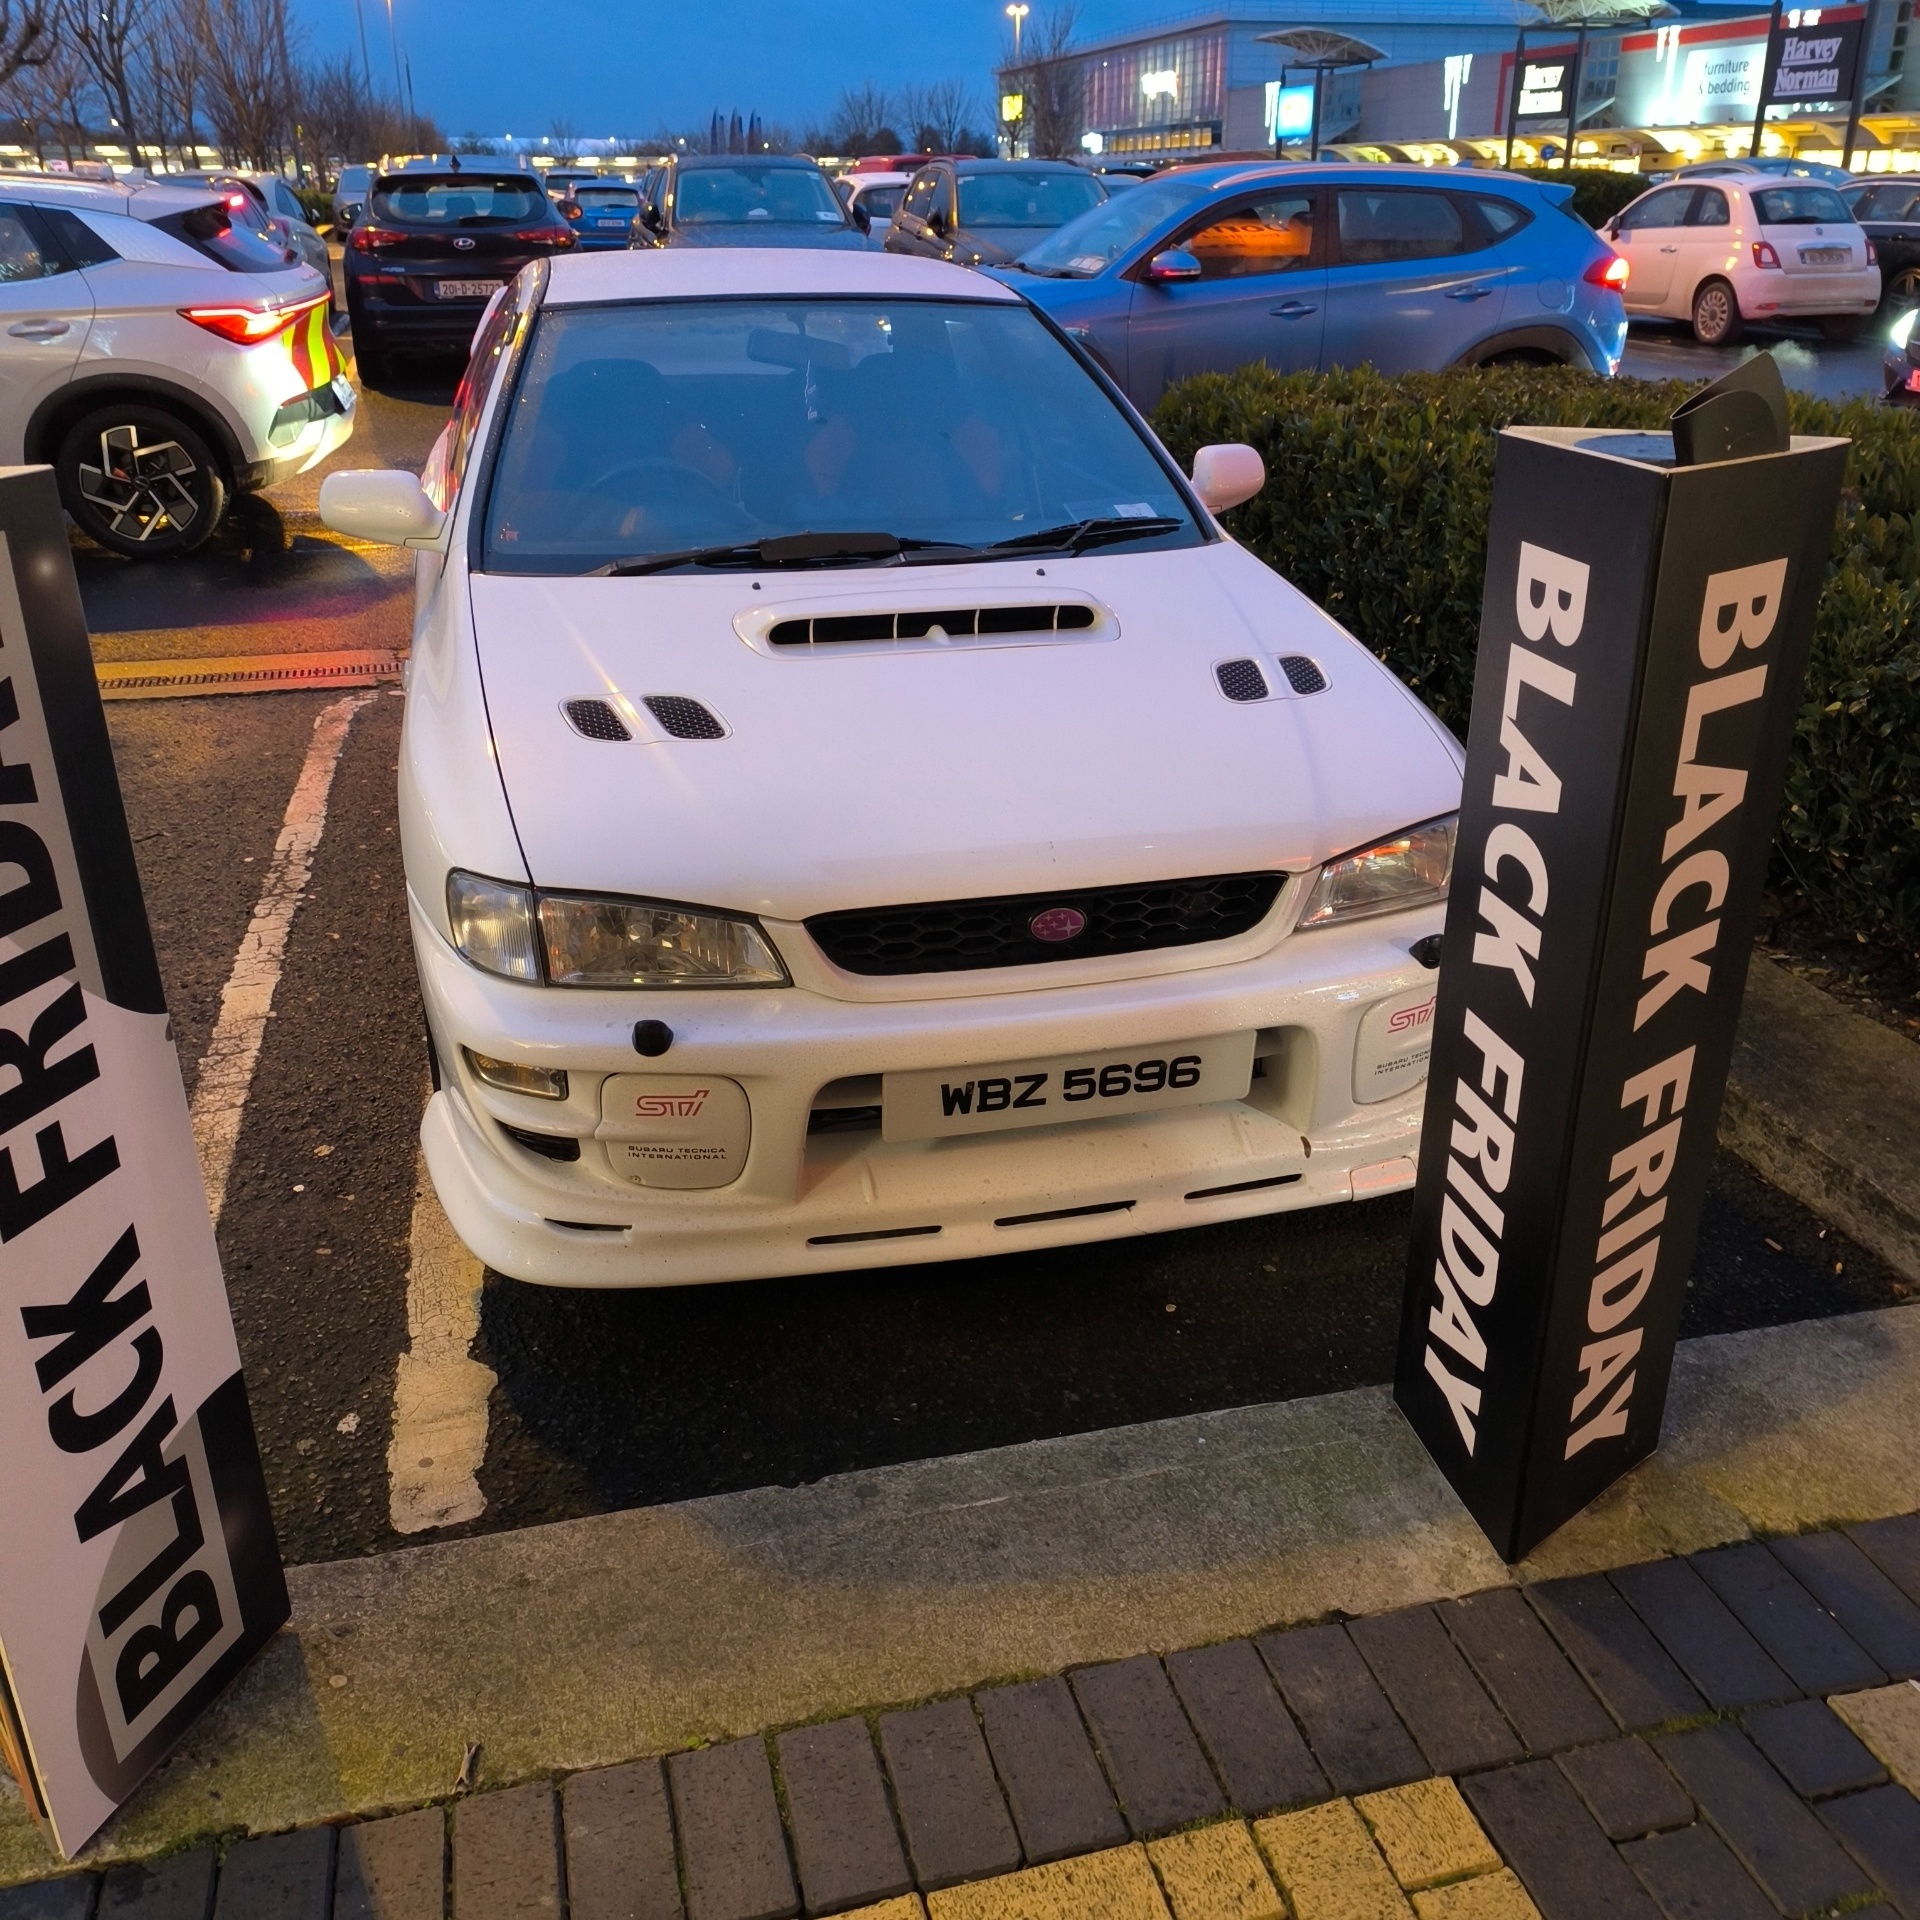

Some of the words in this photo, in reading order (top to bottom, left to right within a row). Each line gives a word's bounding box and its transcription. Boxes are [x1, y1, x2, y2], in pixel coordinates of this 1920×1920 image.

[1705, 59, 1749, 75] furniture
[1781, 37, 1843, 65] Harvey
[1707, 77, 1750, 95] bedding
[1773, 68, 1839, 94] Norman
[1472, 541, 1590, 1008] BLACK
[1633, 558, 1788, 1032] BLACK
[0, 628, 121, 1244] FRID
[1376, 1056, 1409, 1070] SUBARU
[941, 1073, 1048, 1117] WBZ
[1063, 1055, 1202, 1101] 5696
[628, 1145, 674, 1153] SUBARU
[628, 1152, 727, 1160] INTERNATIONAL
[1424, 1008, 1525, 1457] FRIDAY
[1565, 1045, 1696, 1460] FRIDAY
[20, 1221, 224, 1726] BLACK
